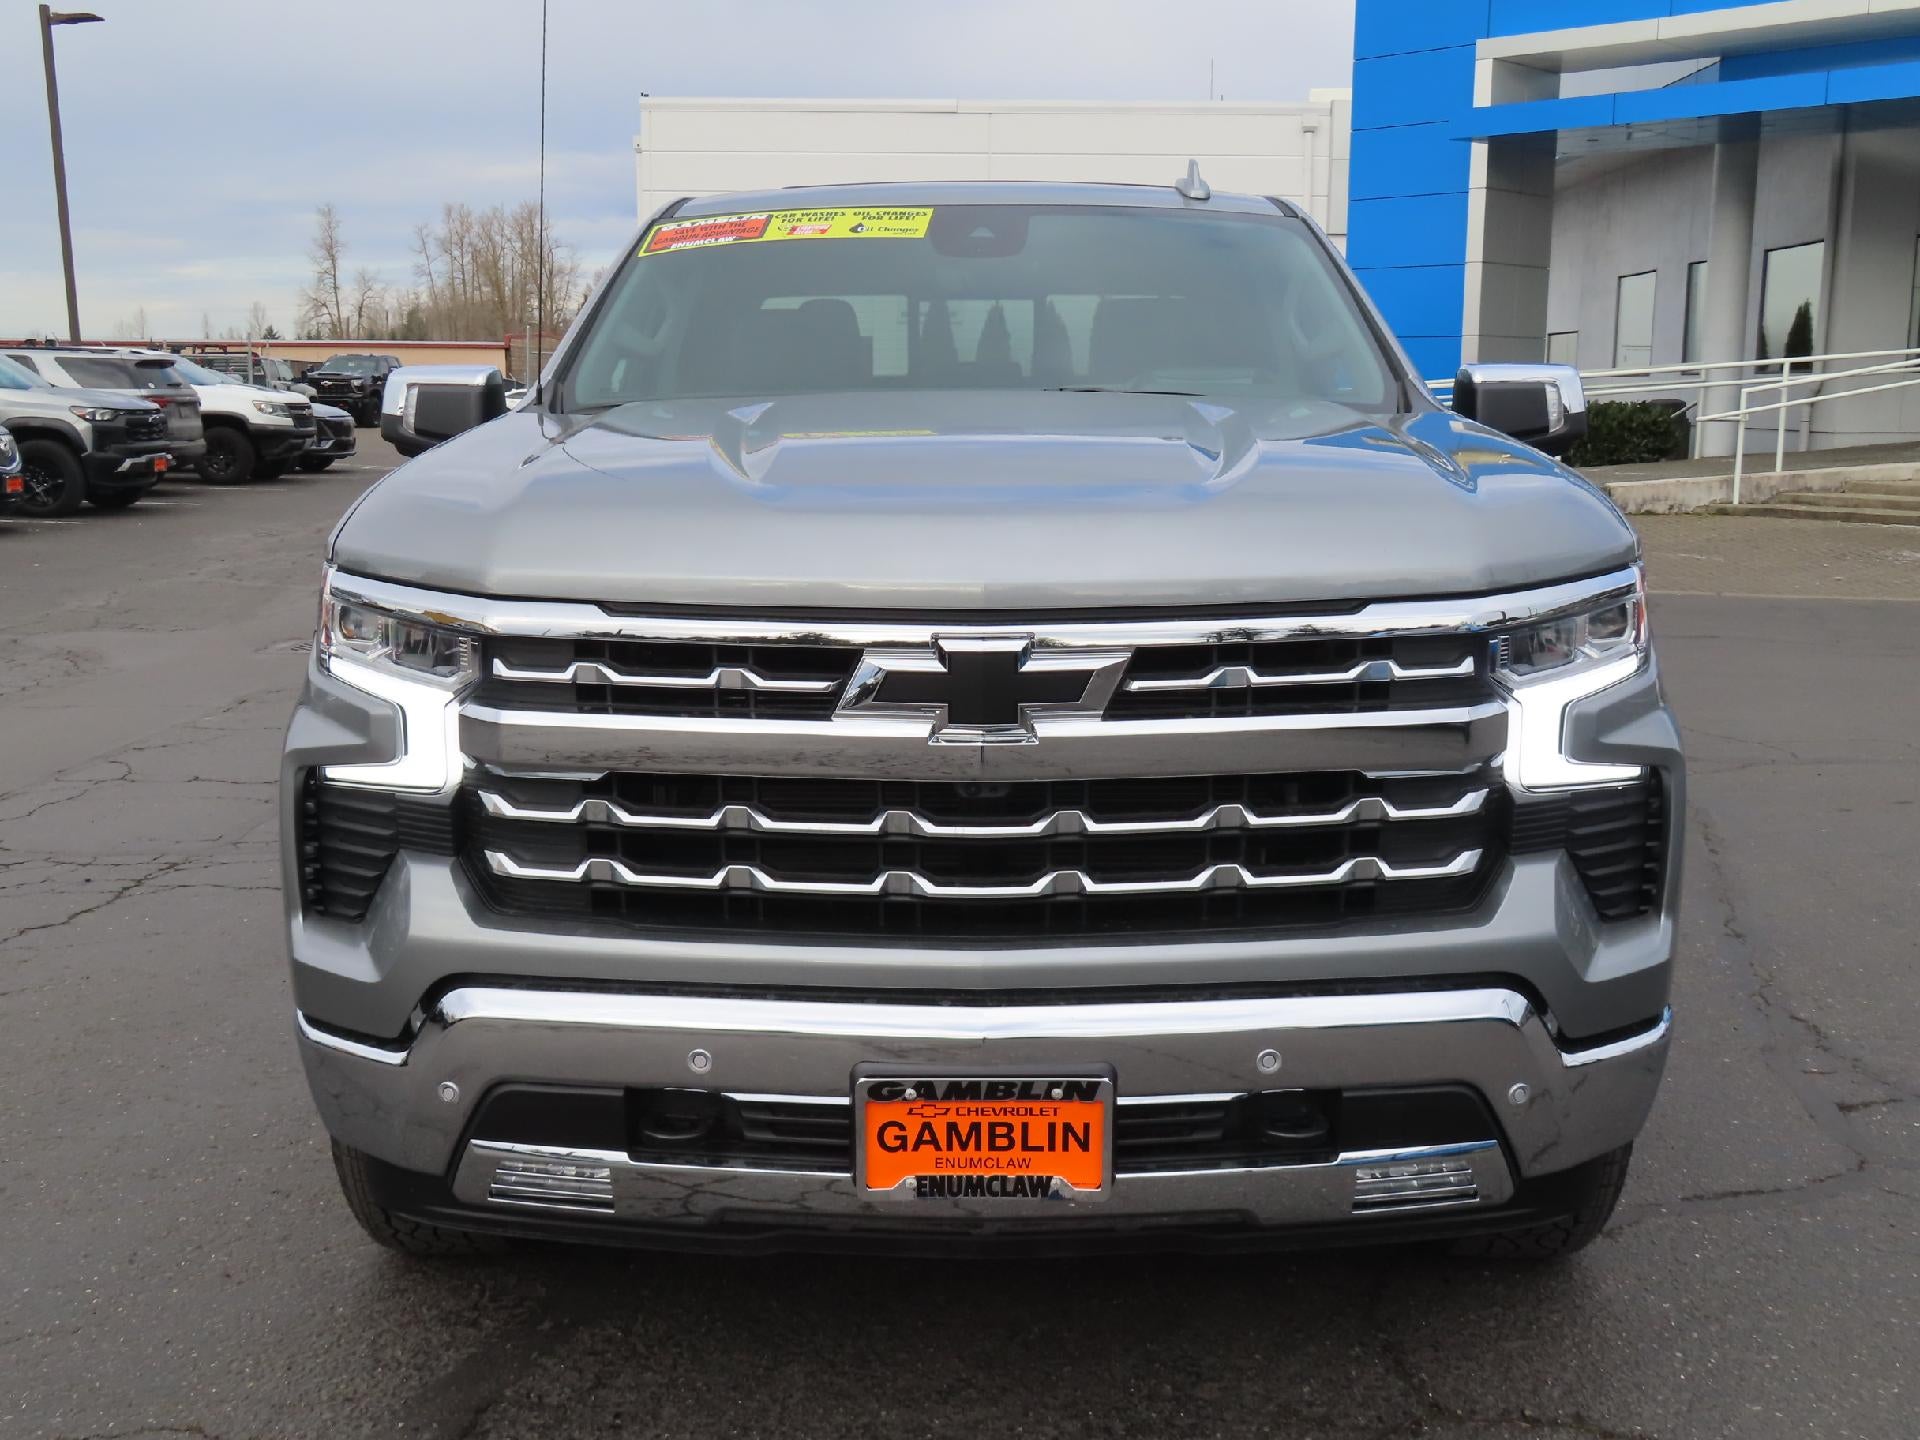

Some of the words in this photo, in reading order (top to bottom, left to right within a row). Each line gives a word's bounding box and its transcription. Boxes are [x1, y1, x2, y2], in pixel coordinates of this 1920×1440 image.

[700, 223, 726, 232] WITH
[730, 221, 746, 229] THE
[867, 1081, 1101, 1101] GAMBLIN
[956, 1107, 1061, 1117] CHEVROLET
[877, 1120, 1091, 1153] GAMBLIN
[935, 1157, 1032, 1169] ENUMCLAW
[916, 1175, 1053, 1198] ENUMCLAW
